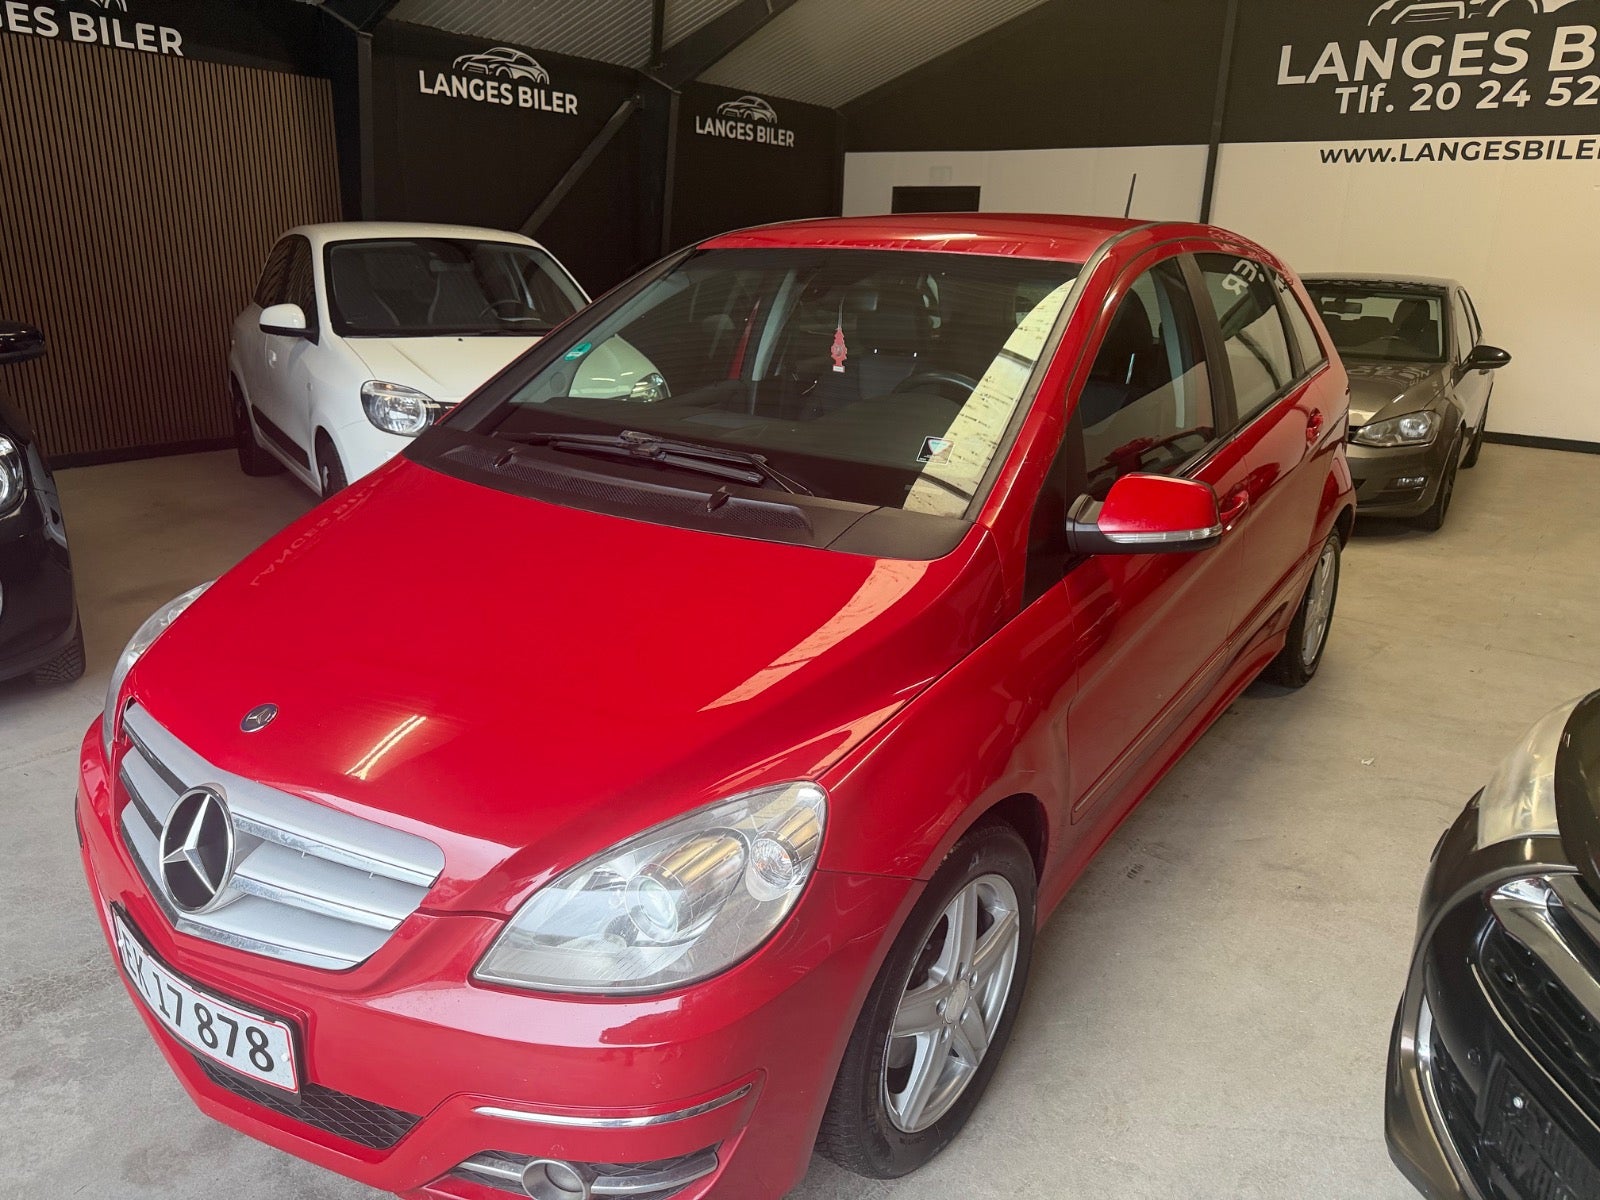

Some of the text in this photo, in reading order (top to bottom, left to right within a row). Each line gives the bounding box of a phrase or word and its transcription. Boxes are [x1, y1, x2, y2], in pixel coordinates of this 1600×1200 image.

[69, 11, 184, 56] BILER
[1277, 29, 1532, 85] LANGES
[419, 70, 578, 115] LANGES BILER
[1335, 75, 1600, 114] Tlf. 20 24 52
[696, 115, 794, 148] LANGES BILER
[1319, 138, 1600, 164] www.LANGESBILE
[152, 971, 183, 1027] 17
[193, 1002, 275, 1072] 878
